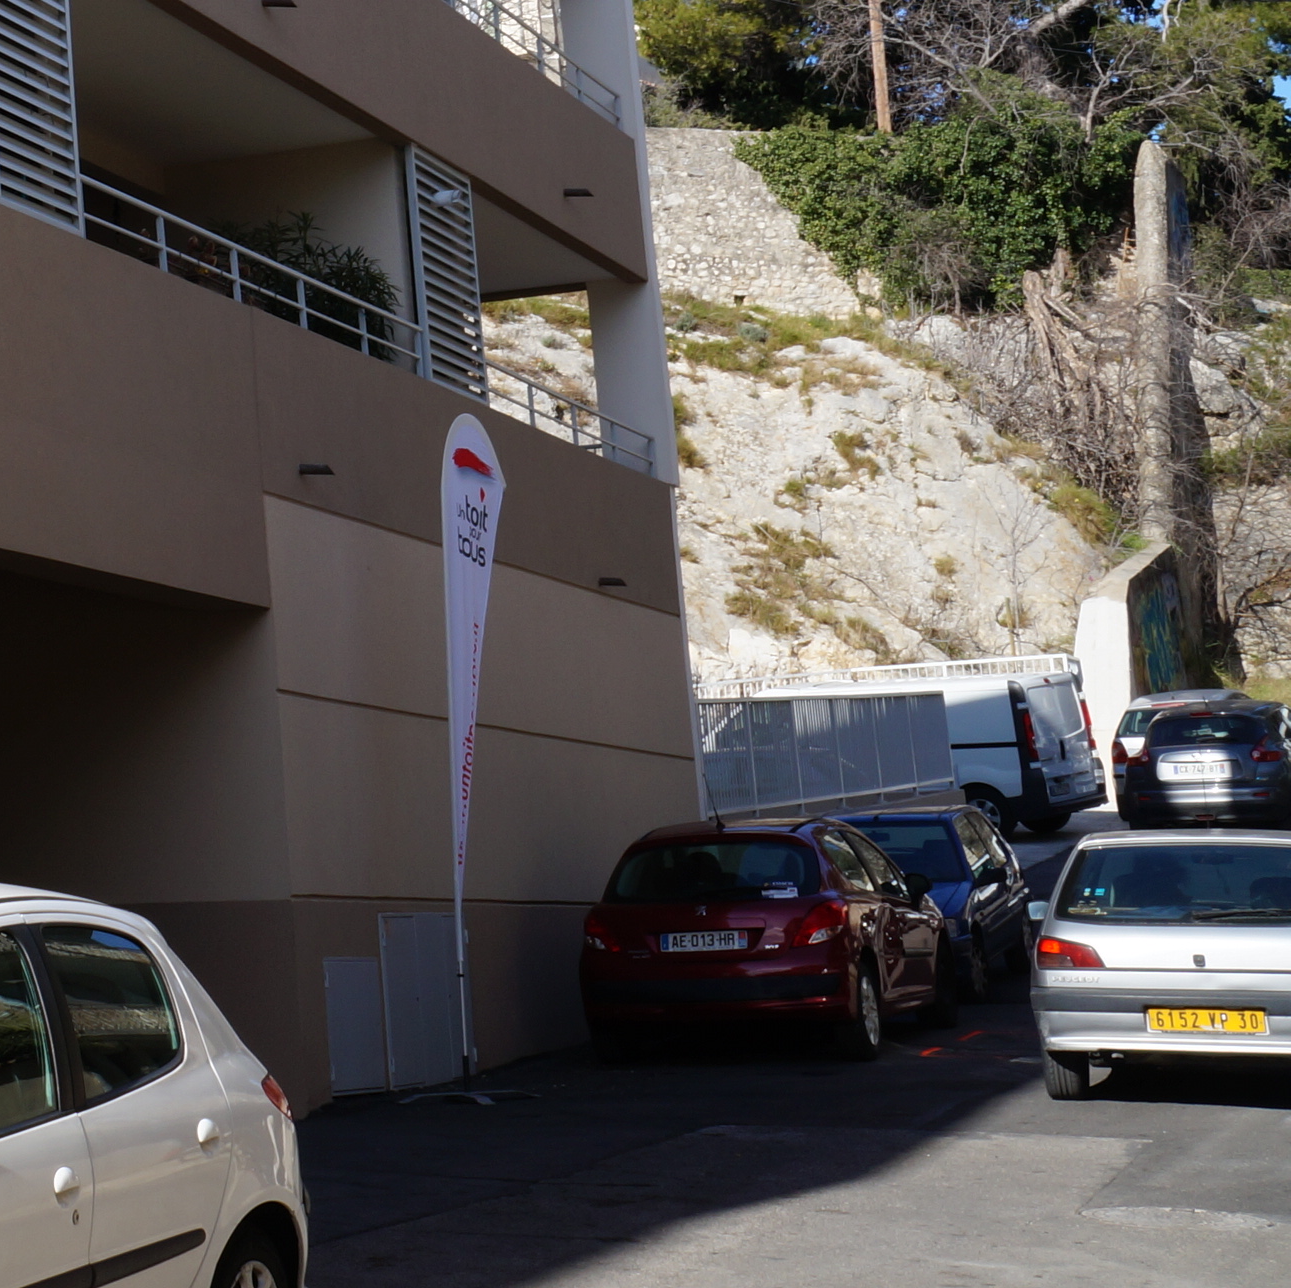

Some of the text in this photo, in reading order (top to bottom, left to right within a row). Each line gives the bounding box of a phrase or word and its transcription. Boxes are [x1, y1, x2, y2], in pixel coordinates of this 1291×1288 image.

[465, 487, 488, 532] toit
[457, 526, 487, 568] tous
[671, 933, 736, 949] AE-013-HR
[1156, 1011, 1259, 1030] 6152 VP 30
